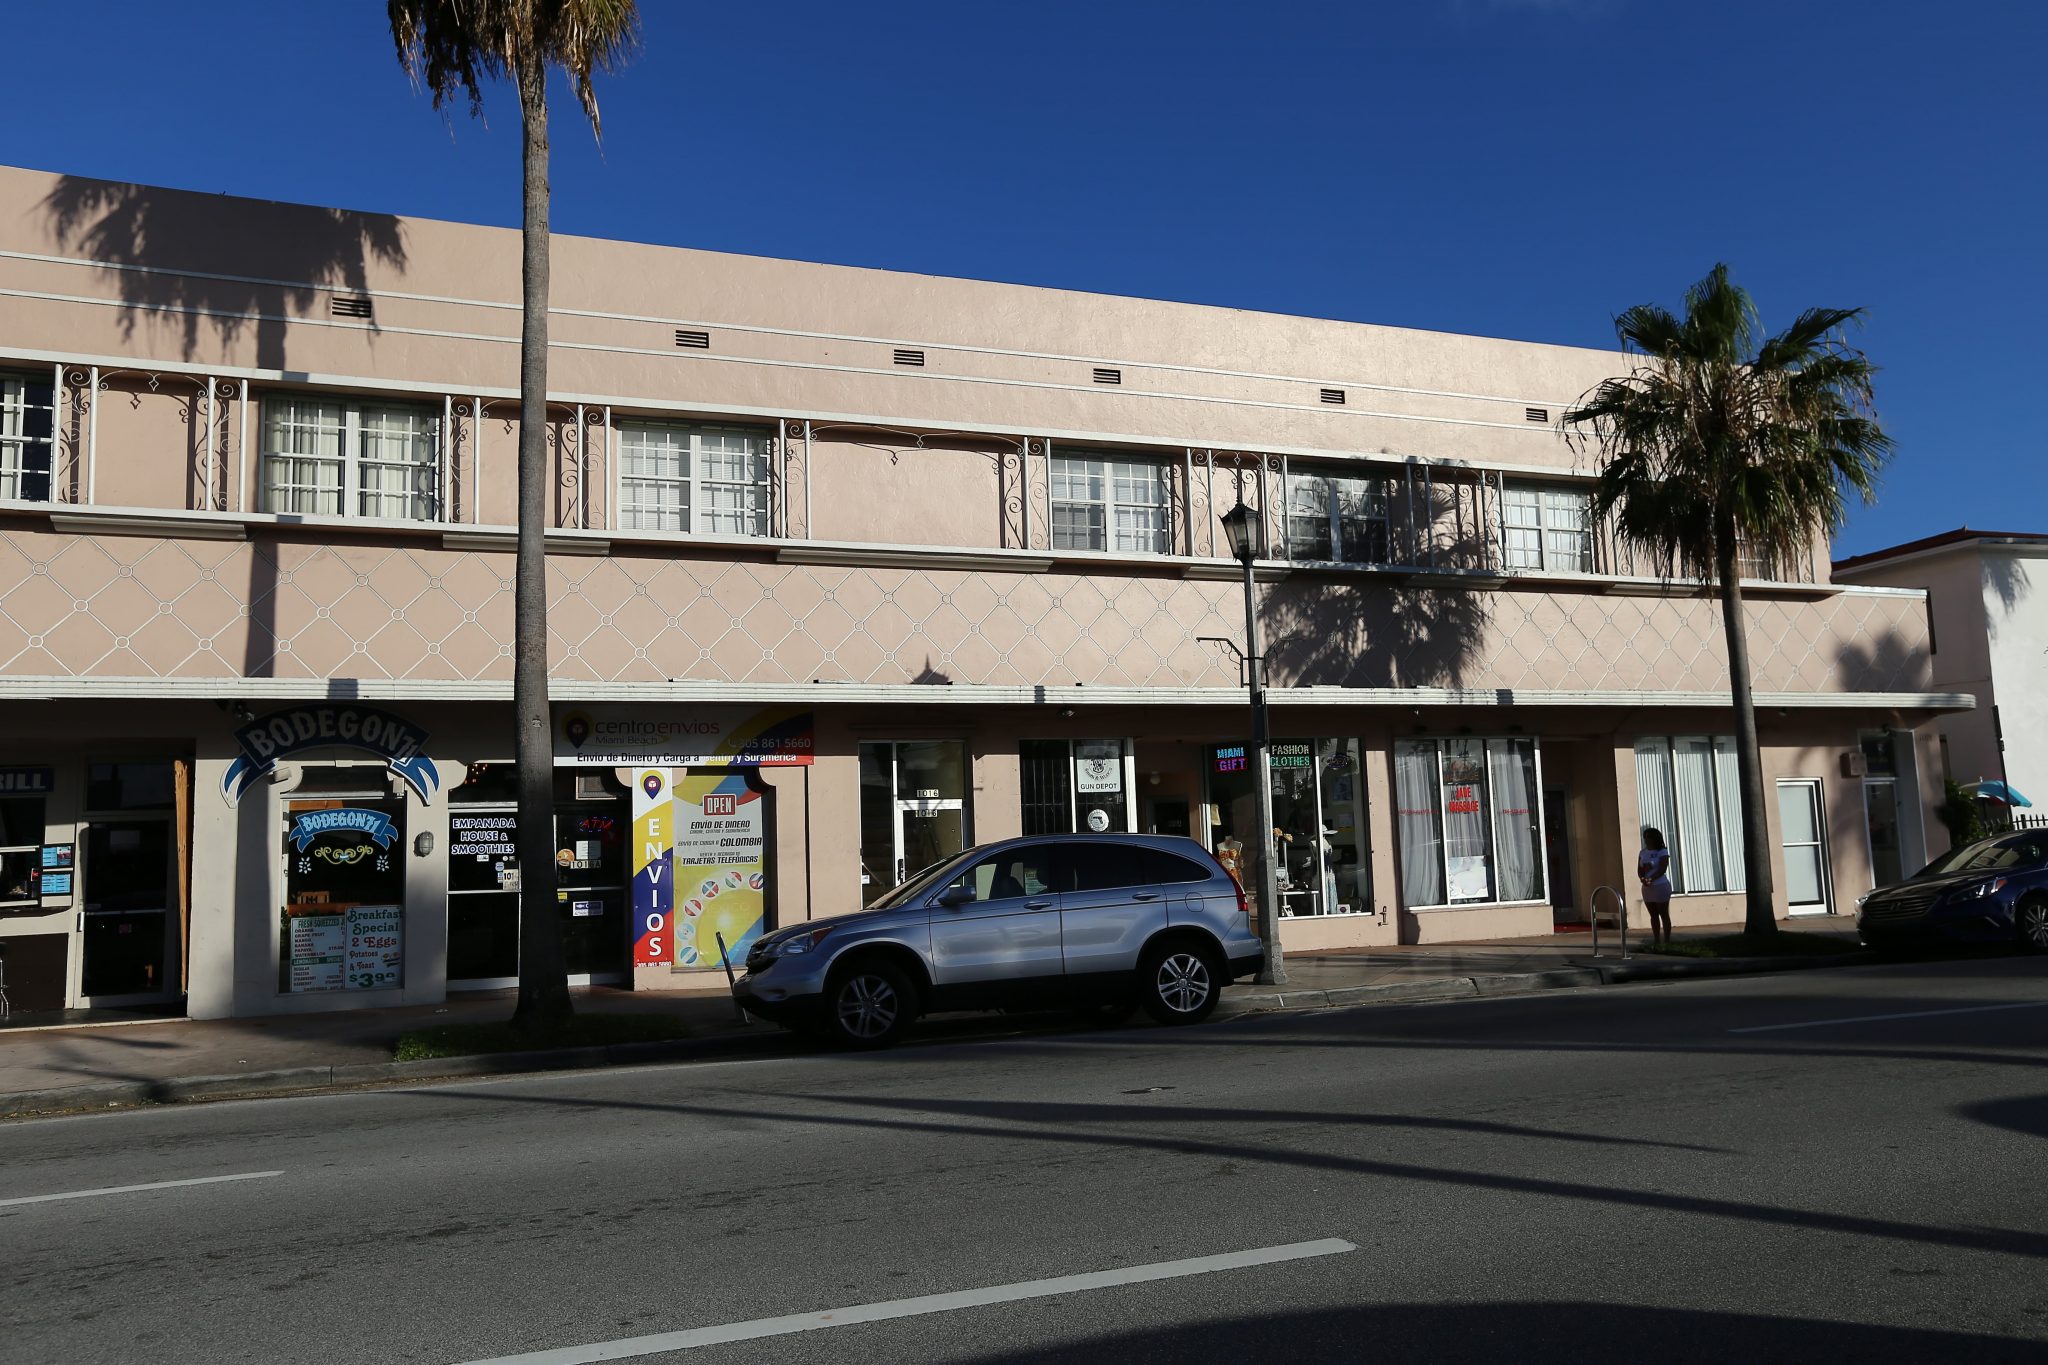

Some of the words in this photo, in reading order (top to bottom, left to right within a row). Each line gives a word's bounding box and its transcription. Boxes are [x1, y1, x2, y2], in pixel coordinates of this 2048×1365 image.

[595, 735, 624, 744] Miami
[628, 735, 658, 744] Beach
[762, 738, 780, 748] 861
[785, 738, 811, 748] 5660
[1216, 746, 1244, 758] MIAMI
[1271, 744, 1310, 755] FASHION
[606, 752, 618, 762] de
[622, 752, 652, 762] Dinero
[654, 754, 660, 764] y
[664, 752, 691, 764] Carga
[1270, 756, 1310, 767] CLOTHES
[1219, 758, 1246, 771] GIFT
[0, 772, 47, 791] ILL
[708, 797, 732, 814] OPEN
[1449, 800, 1479, 812] MASSAGE
[452, 818, 517, 830] EMPANADA
[714, 820, 724, 829] DE
[725, 820, 751, 828] DINERO
[460, 830, 499, 842] HOUSE
[500, 832, 508, 841] &
[720, 837, 762, 847] COLOMBIA
[451, 844, 516, 856] SMOOTHIES
[645, 818, 664, 957] ENVIOS
[352, 922, 400, 936] Special
[352, 937, 360, 947] 2
[364, 936, 397, 948] Eggs
[350, 950, 379, 960] Potatoes
[356, 961, 375, 971] Toast
